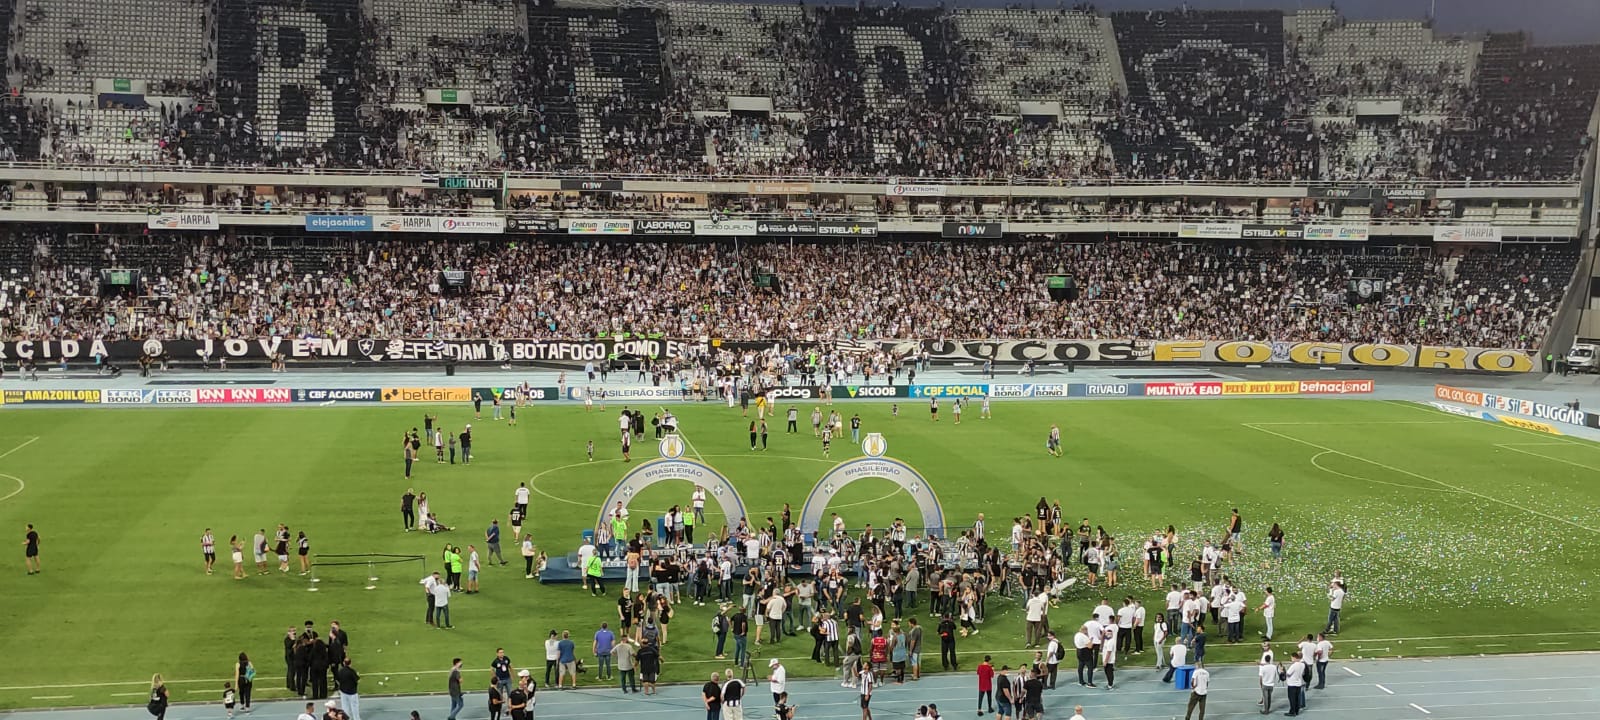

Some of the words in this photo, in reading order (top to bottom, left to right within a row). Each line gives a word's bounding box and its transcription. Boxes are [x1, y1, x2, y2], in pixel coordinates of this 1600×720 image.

[180, 214, 211, 225] HARPIA
[312, 217, 367, 229] elejaonline
[403, 217, 432, 228] HARPIA
[572, 220, 598, 229] Centrum
[641, 221, 692, 229] LABORMED
[603, 221, 630, 230] Centrum
[819, 226, 854, 234] ESTRELA
[861, 227, 877, 235] BET
[1243, 229, 1280, 237] ESTRELA
[1464, 227, 1495, 238] HARPIA
[196, 338, 348, 357] JOVEM
[512, 341, 606, 361] BOTAFOGO
[613, 339, 660, 359] COMO
[771, 387, 811, 398] pdog
[858, 387, 897, 396] SICOOB
[924, 386, 944, 396] CBF
[946, 386, 985, 396] SOCIAL
[1088, 385, 1126, 395] RIVALO
[1146, 385, 1198, 396] MULTIVIX
[1199, 385, 1222, 395] EAD
[1300, 380, 1372, 394] betnacional
[24, 390, 100, 401] AMAZONLORD
[199, 389, 225, 400] KNN
[231, 389, 257, 400] KNN
[263, 389, 289, 400] KNN
[309, 390, 327, 399] CBF
[328, 390, 375, 399] ACADEMY
[504, 389, 545, 399] SIOB
[1437, 386, 1451, 398] GOL
[1451, 389, 1465, 402] GOL
[1466, 392, 1481, 405] GOL
[1485, 394, 1497, 408] Sil
[1508, 399, 1521, 413] Sil
[1534, 403, 1585, 426] SUGGAR
[645, 467, 703, 478] BRASILEIRÃO
[845, 465, 901, 476] BRASILEIRÃO
